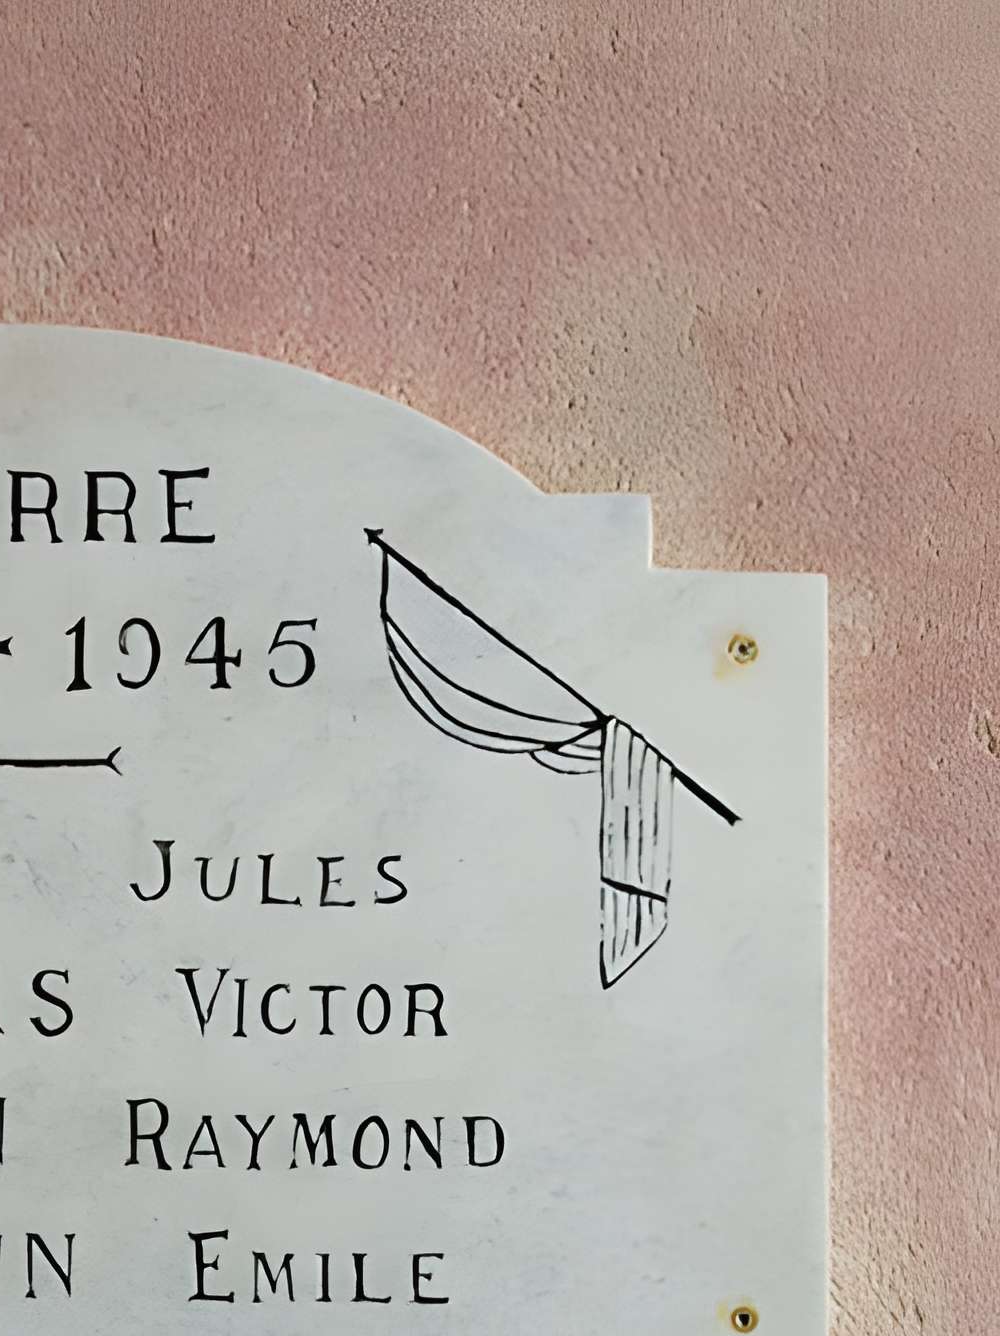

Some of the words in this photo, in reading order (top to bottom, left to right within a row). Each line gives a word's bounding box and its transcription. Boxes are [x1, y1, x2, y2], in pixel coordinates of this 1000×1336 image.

[63, 615, 319, 694] 1945
[129, 838, 409, 908] JULES
[174, 967, 449, 1039] VICTOR
[124, 1096, 506, 1172] RAYMOND
[187, 1229, 451, 1305] EMILE
